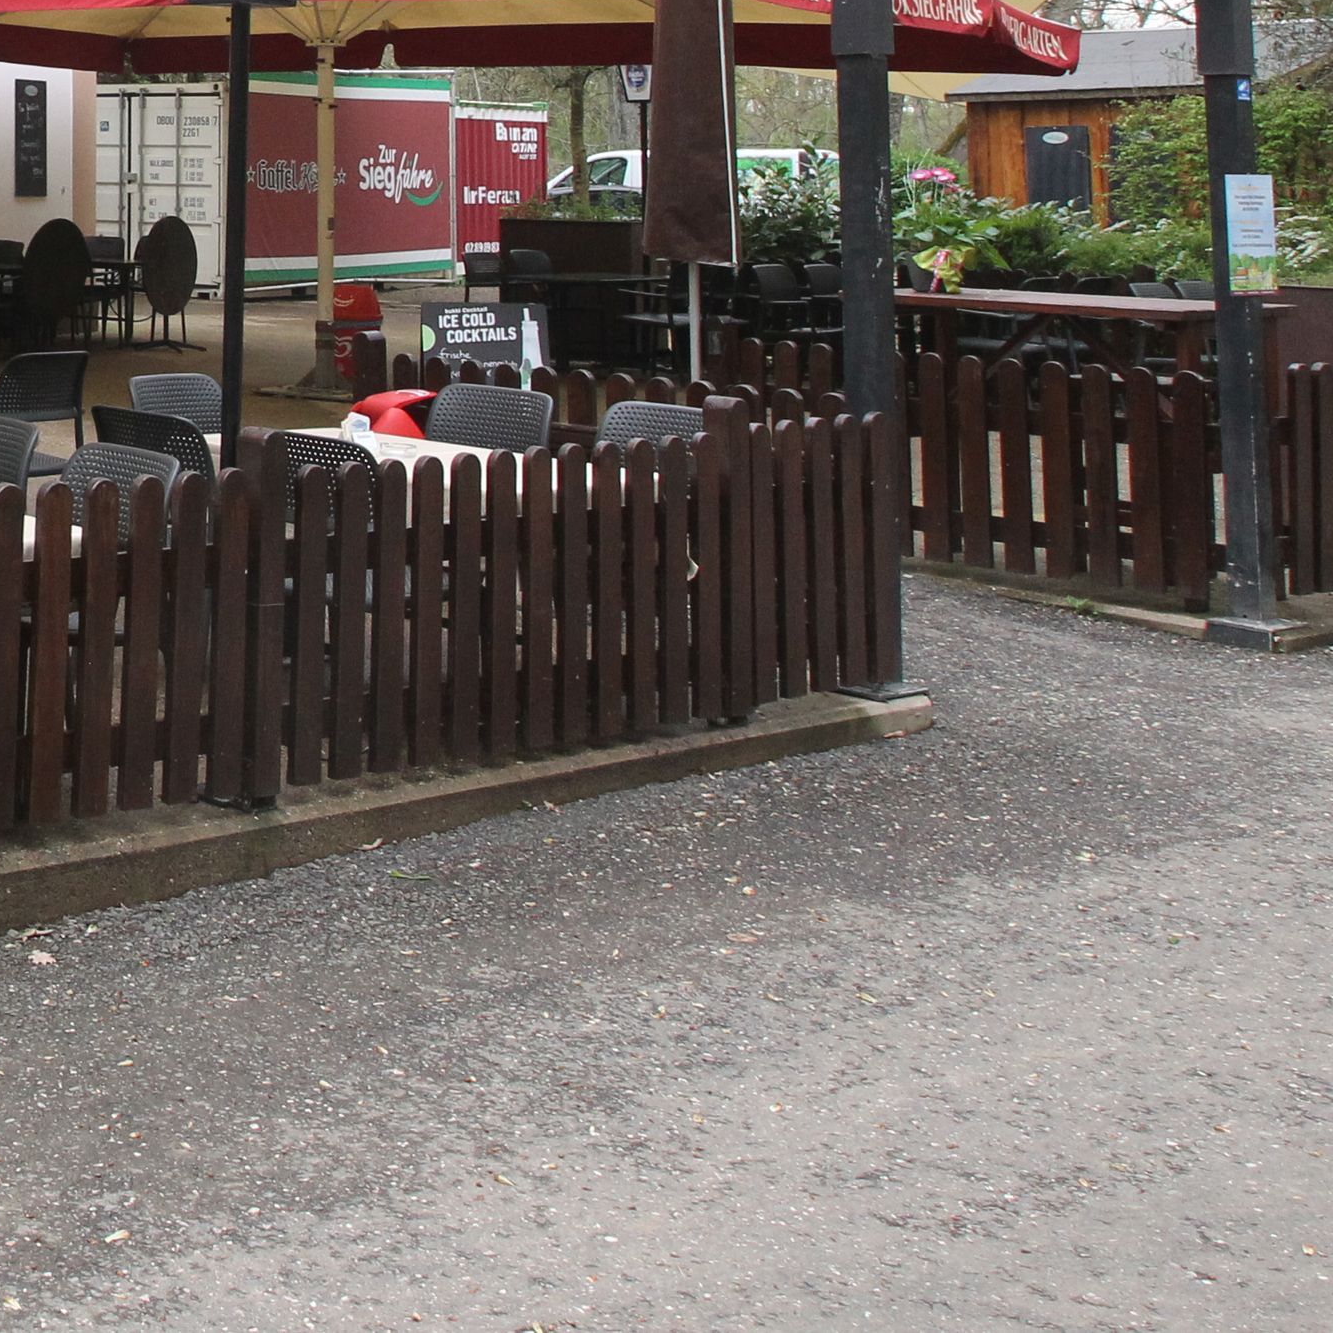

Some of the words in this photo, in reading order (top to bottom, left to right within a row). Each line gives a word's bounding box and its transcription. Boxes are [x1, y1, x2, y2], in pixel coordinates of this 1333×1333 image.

[377, 144, 397, 164] Zur
[438, 314, 460, 329] ICE
[461, 312, 496, 328] COLD
[446, 326, 518, 344] COCKTAILS
